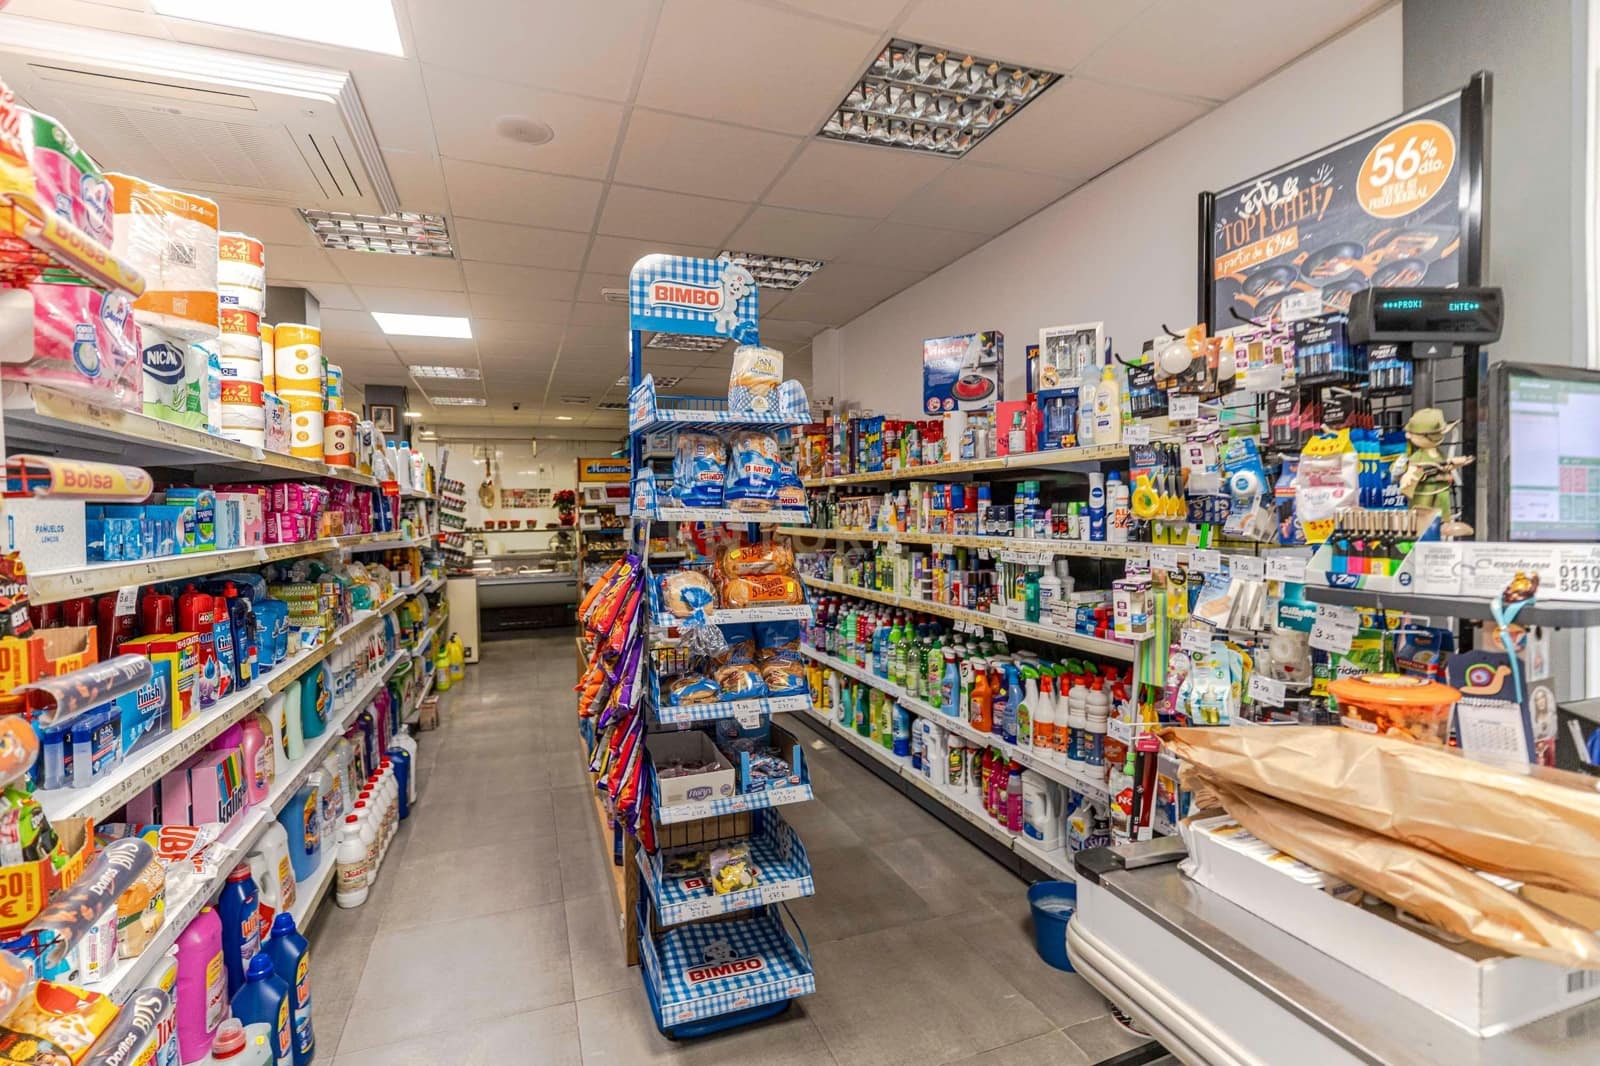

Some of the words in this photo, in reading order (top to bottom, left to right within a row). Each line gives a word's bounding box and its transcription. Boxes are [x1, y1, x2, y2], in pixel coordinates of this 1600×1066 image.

[1421, 138, 1438, 158] %
[1369, 136, 1421, 187] 56
[1223, 217, 1256, 251] TOP
[655, 286, 719, 306] BIMBO
[222, 395, 252, 404] GRATIS
[223, 385, 248, 398] 4+2
[62, 469, 113, 490] Bolsa
[1337, 665, 1368, 676] Trident
[138, 684, 160, 706] finish
[109, 843, 140, 870] BITS
[90, 868, 118, 896] Doritos
[689, 958, 762, 982] BIMBO
[133, 995, 162, 1034] BITS
[106, 1032, 138, 1066] Doritos
